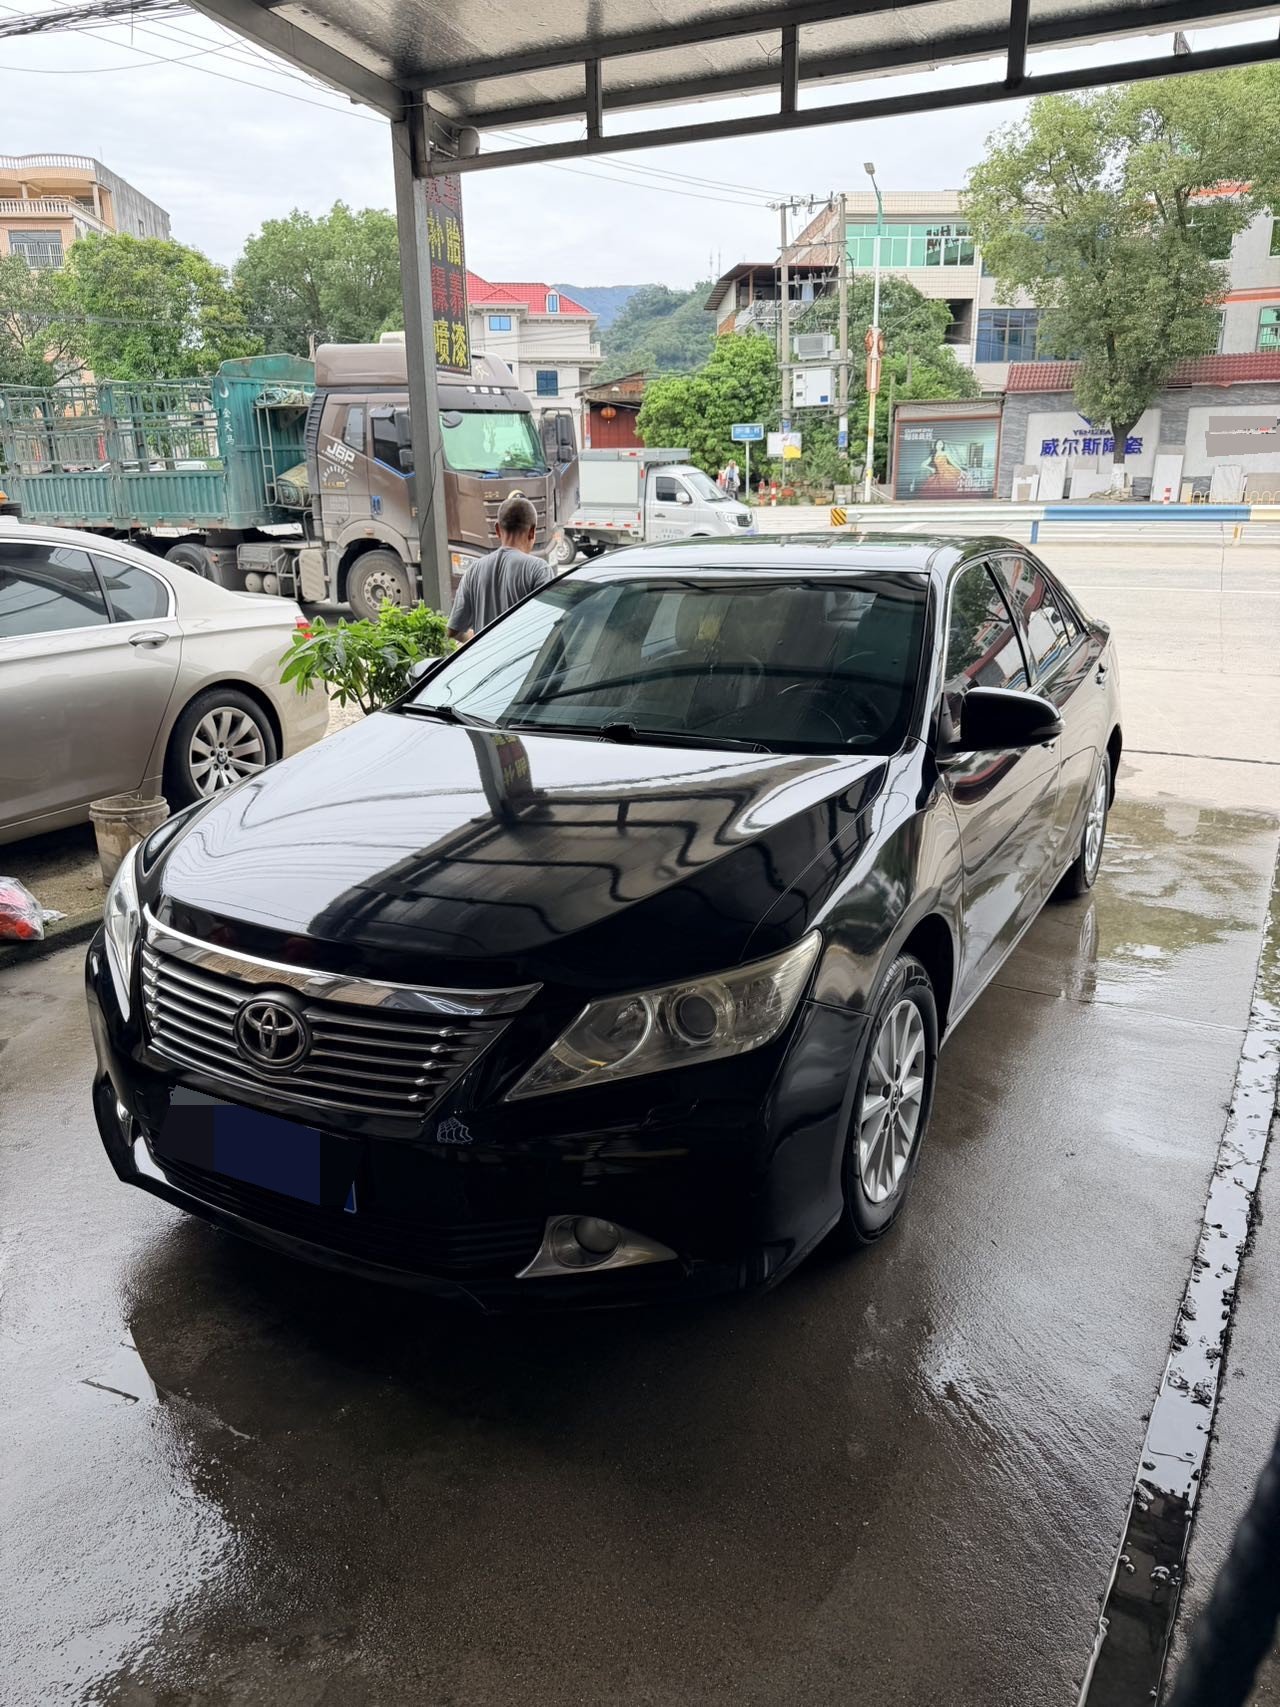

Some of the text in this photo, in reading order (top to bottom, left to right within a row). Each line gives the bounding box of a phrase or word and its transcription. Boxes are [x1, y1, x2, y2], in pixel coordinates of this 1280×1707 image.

[427, 208, 463, 266] 补胎
[433, 317, 467, 367] 喷漆
[222, 407, 235, 445] 金天马
[1040, 435, 1144, 457] 威尔斯陶瓷
